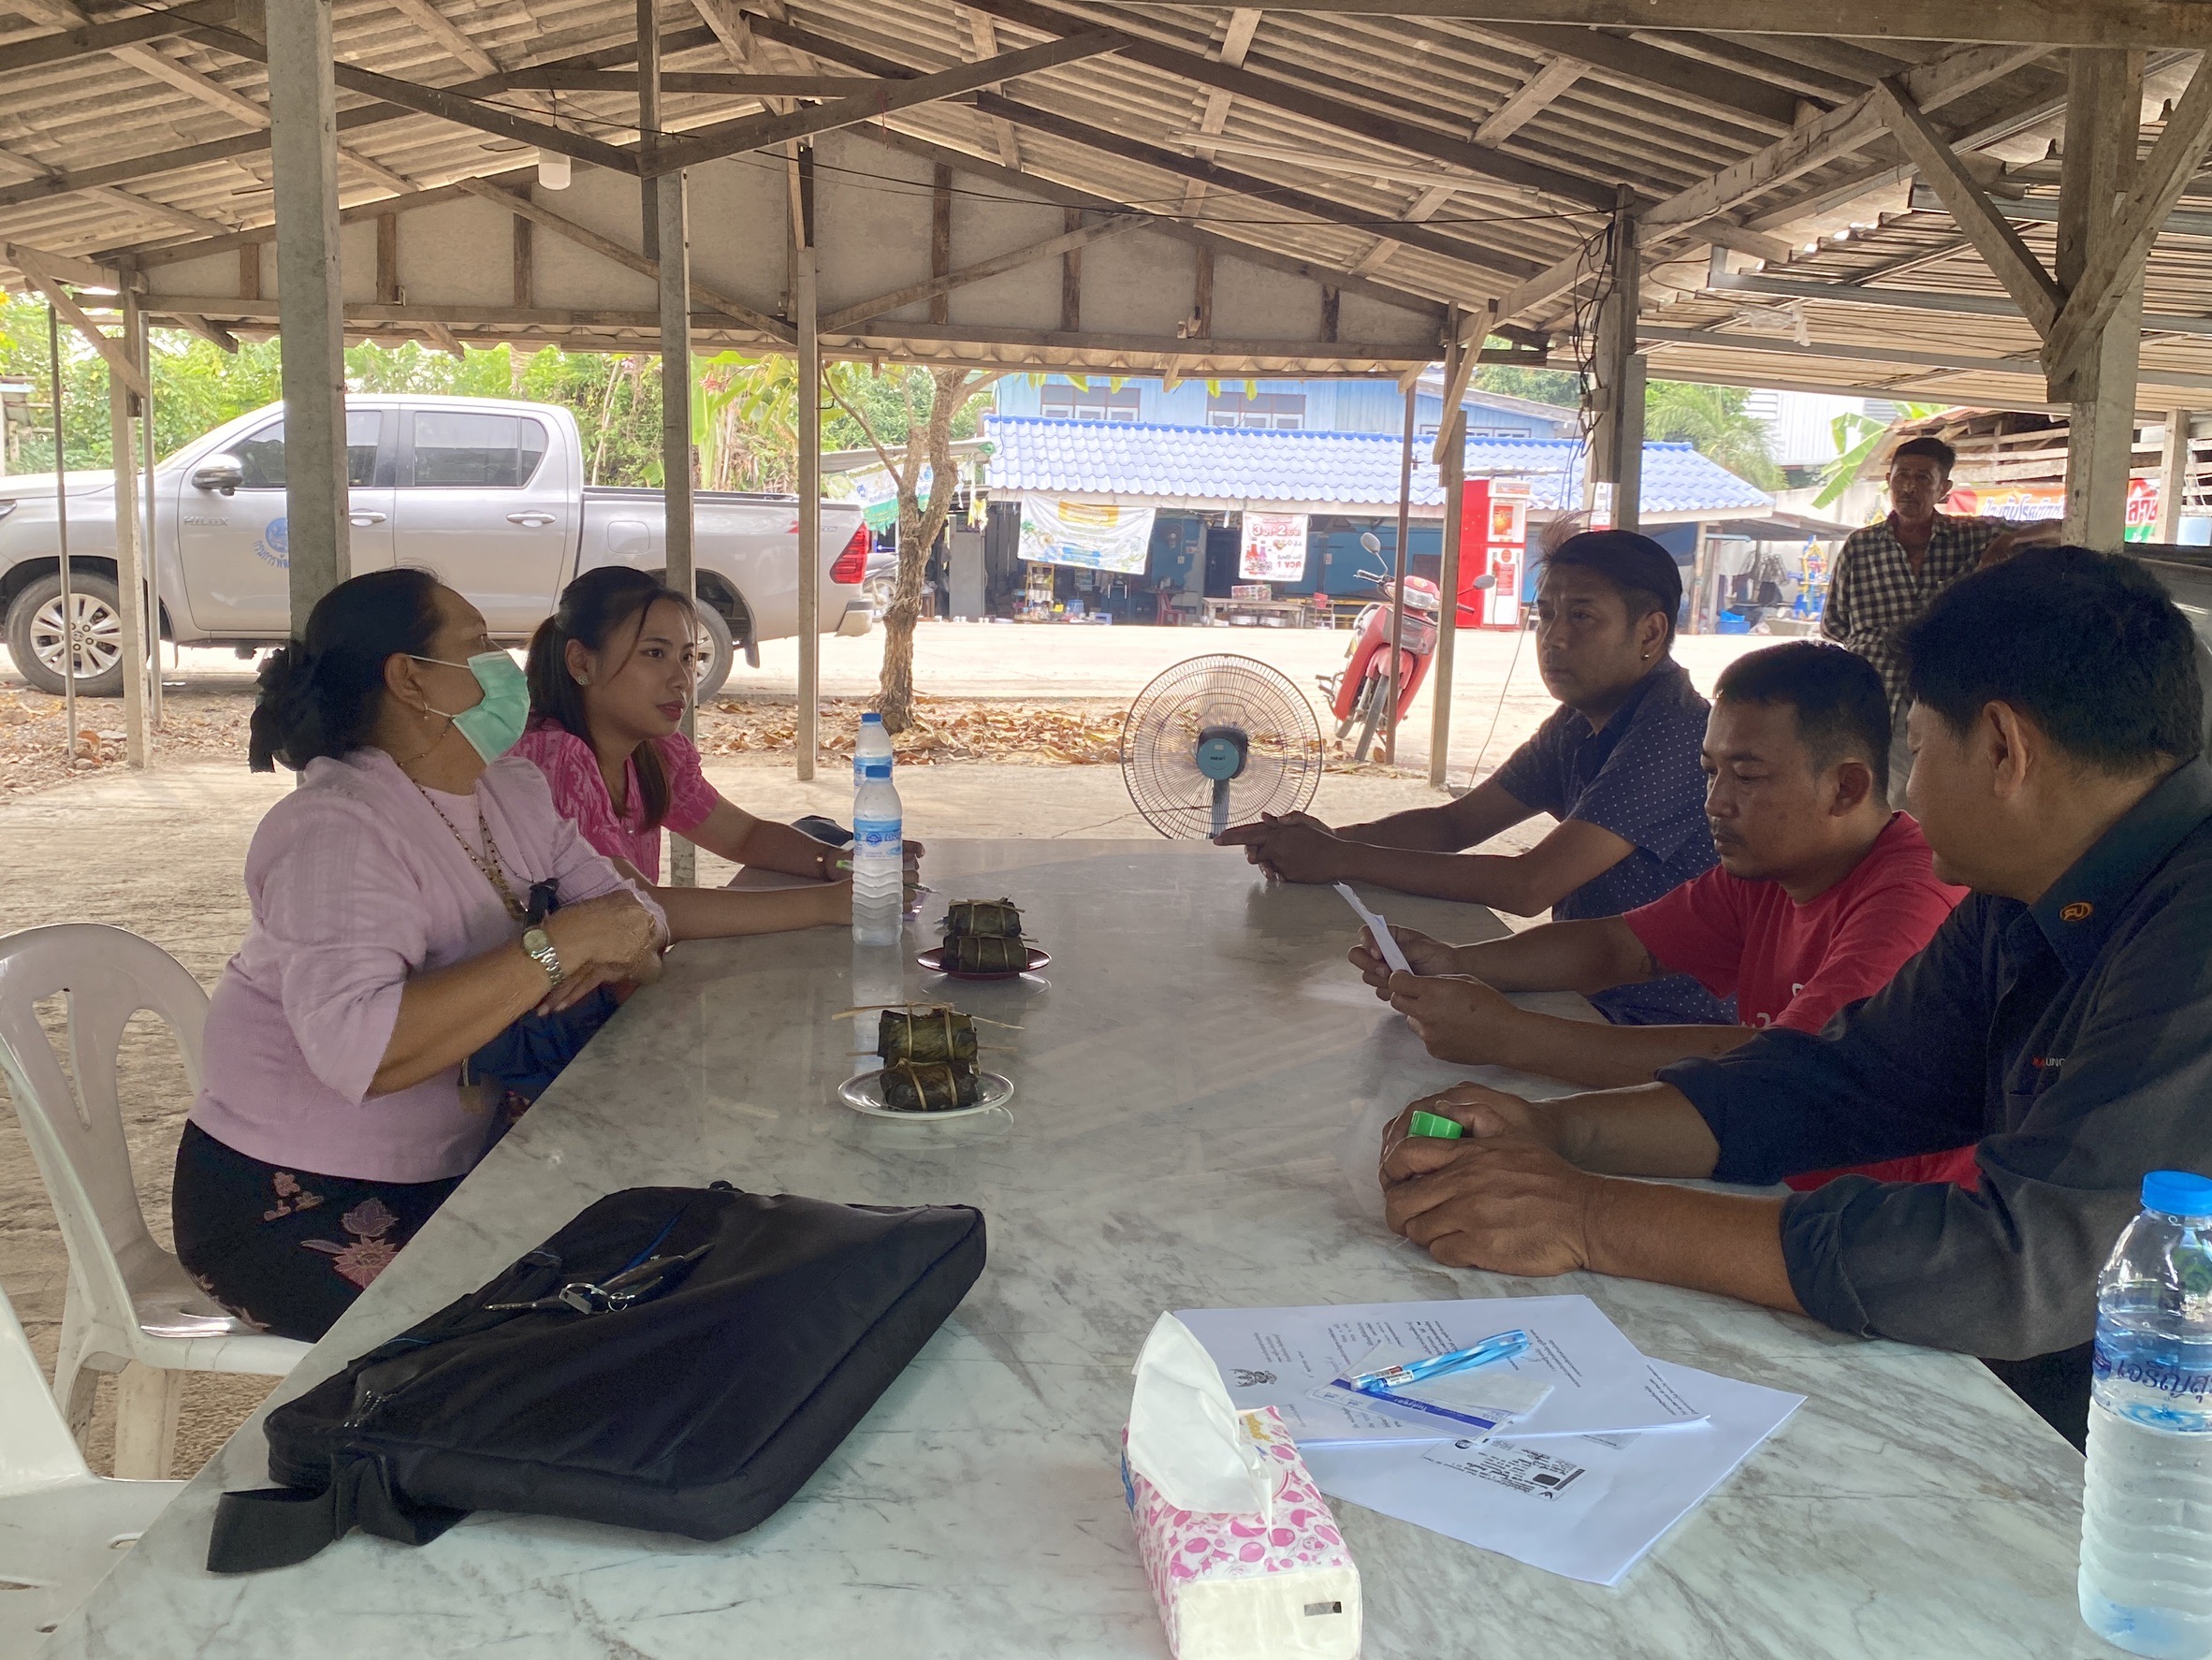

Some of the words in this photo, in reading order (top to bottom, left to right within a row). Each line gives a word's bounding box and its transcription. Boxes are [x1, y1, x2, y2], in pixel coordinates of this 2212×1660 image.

[183, 516, 230, 526] HILUX
[2117, 1359, 2212, 1404] เจริญสุ
